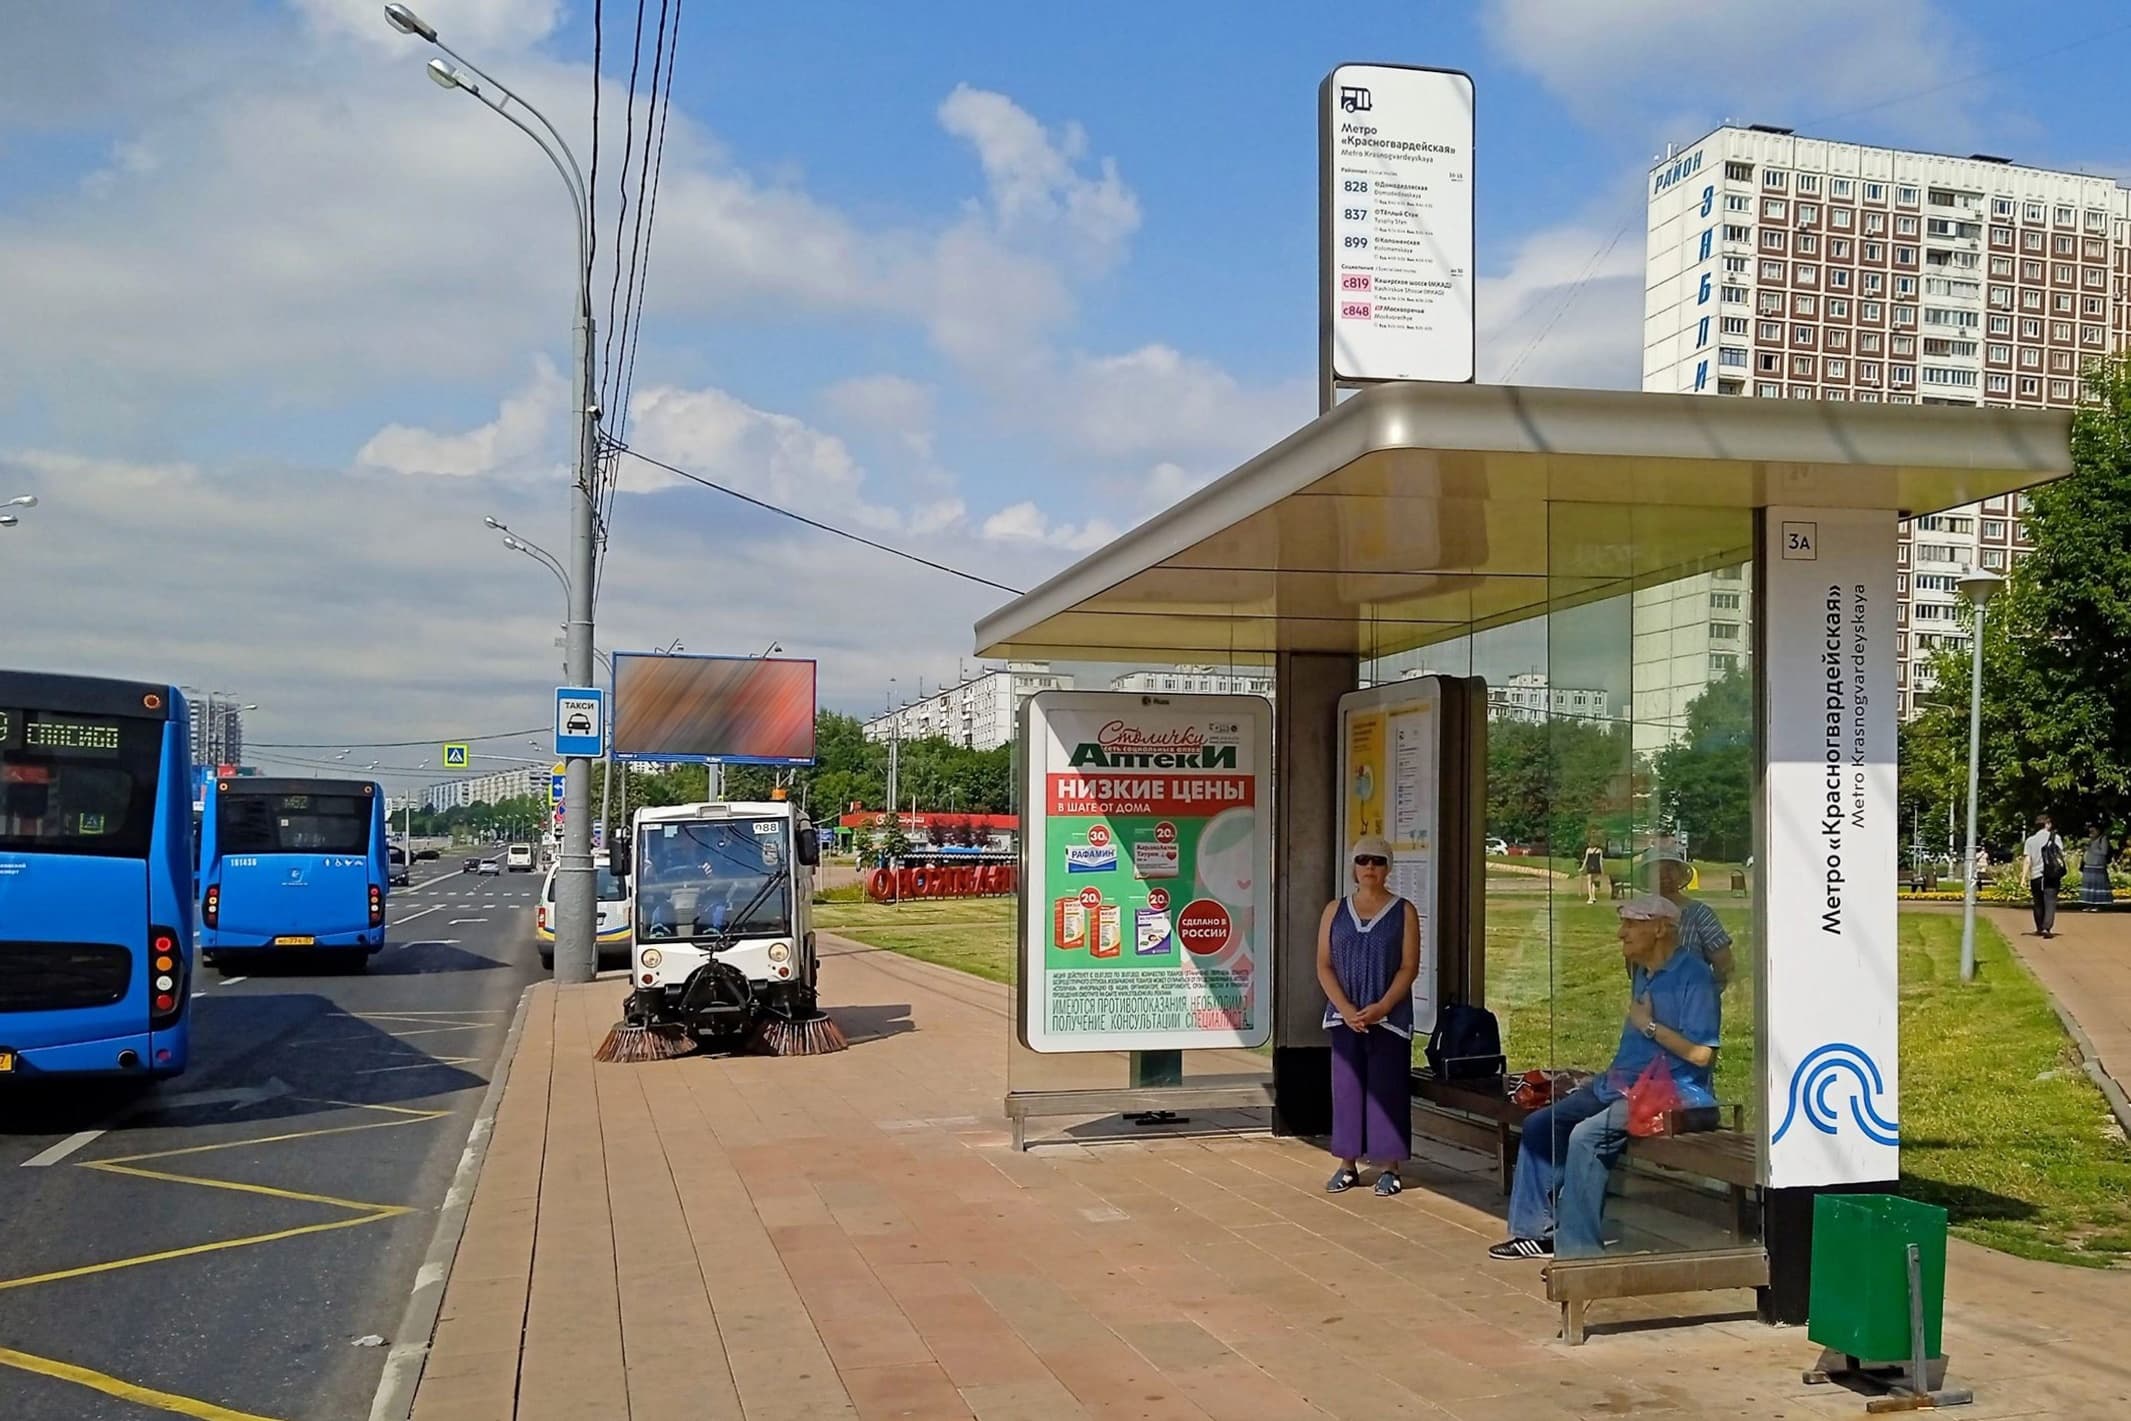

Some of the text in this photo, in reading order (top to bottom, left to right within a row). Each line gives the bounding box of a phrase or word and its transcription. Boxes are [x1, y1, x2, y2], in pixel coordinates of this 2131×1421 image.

[1341, 123, 1378, 136] Метро
[1341, 136, 1456, 154] «Красногвардейская»
[1341, 150, 1363, 158] Metro
[1654, 150, 1703, 194] РАЙОН
[1344, 181, 1368, 193] 828
[1344, 209, 1367, 221] 837
[1344, 236, 1368, 248] 899
[1344, 279, 1369, 289] с819
[1344, 307, 1369, 316] с848
[565, 702, 594, 710] ТАКСИ
[1851, 584, 1868, 828] Metro Krasnogvardeyskaya
[1098, 720, 1209, 744] Столички
[1822, 585, 1845, 935] Метро «Красногвардейская»
[1058, 779, 1245, 802] НИЗКИЕ ЦЕНЫ
[1058, 804, 1151, 814] В ШАГЕ ОТ ДОМА
[1072, 850, 1114, 859] РАФАМИН
[1182, 918, 1220, 927] СДЕЛАНО
[1182, 929, 1226, 938] РОССИИ
[1053, 998, 1096, 1014] ИМЕЮТСЯ
[1052, 1015, 1105, 1031] ПОЛУЧЕНИЕ
[1111, 1014, 1180, 1030] КОНСУЛЬТАЦИИ
